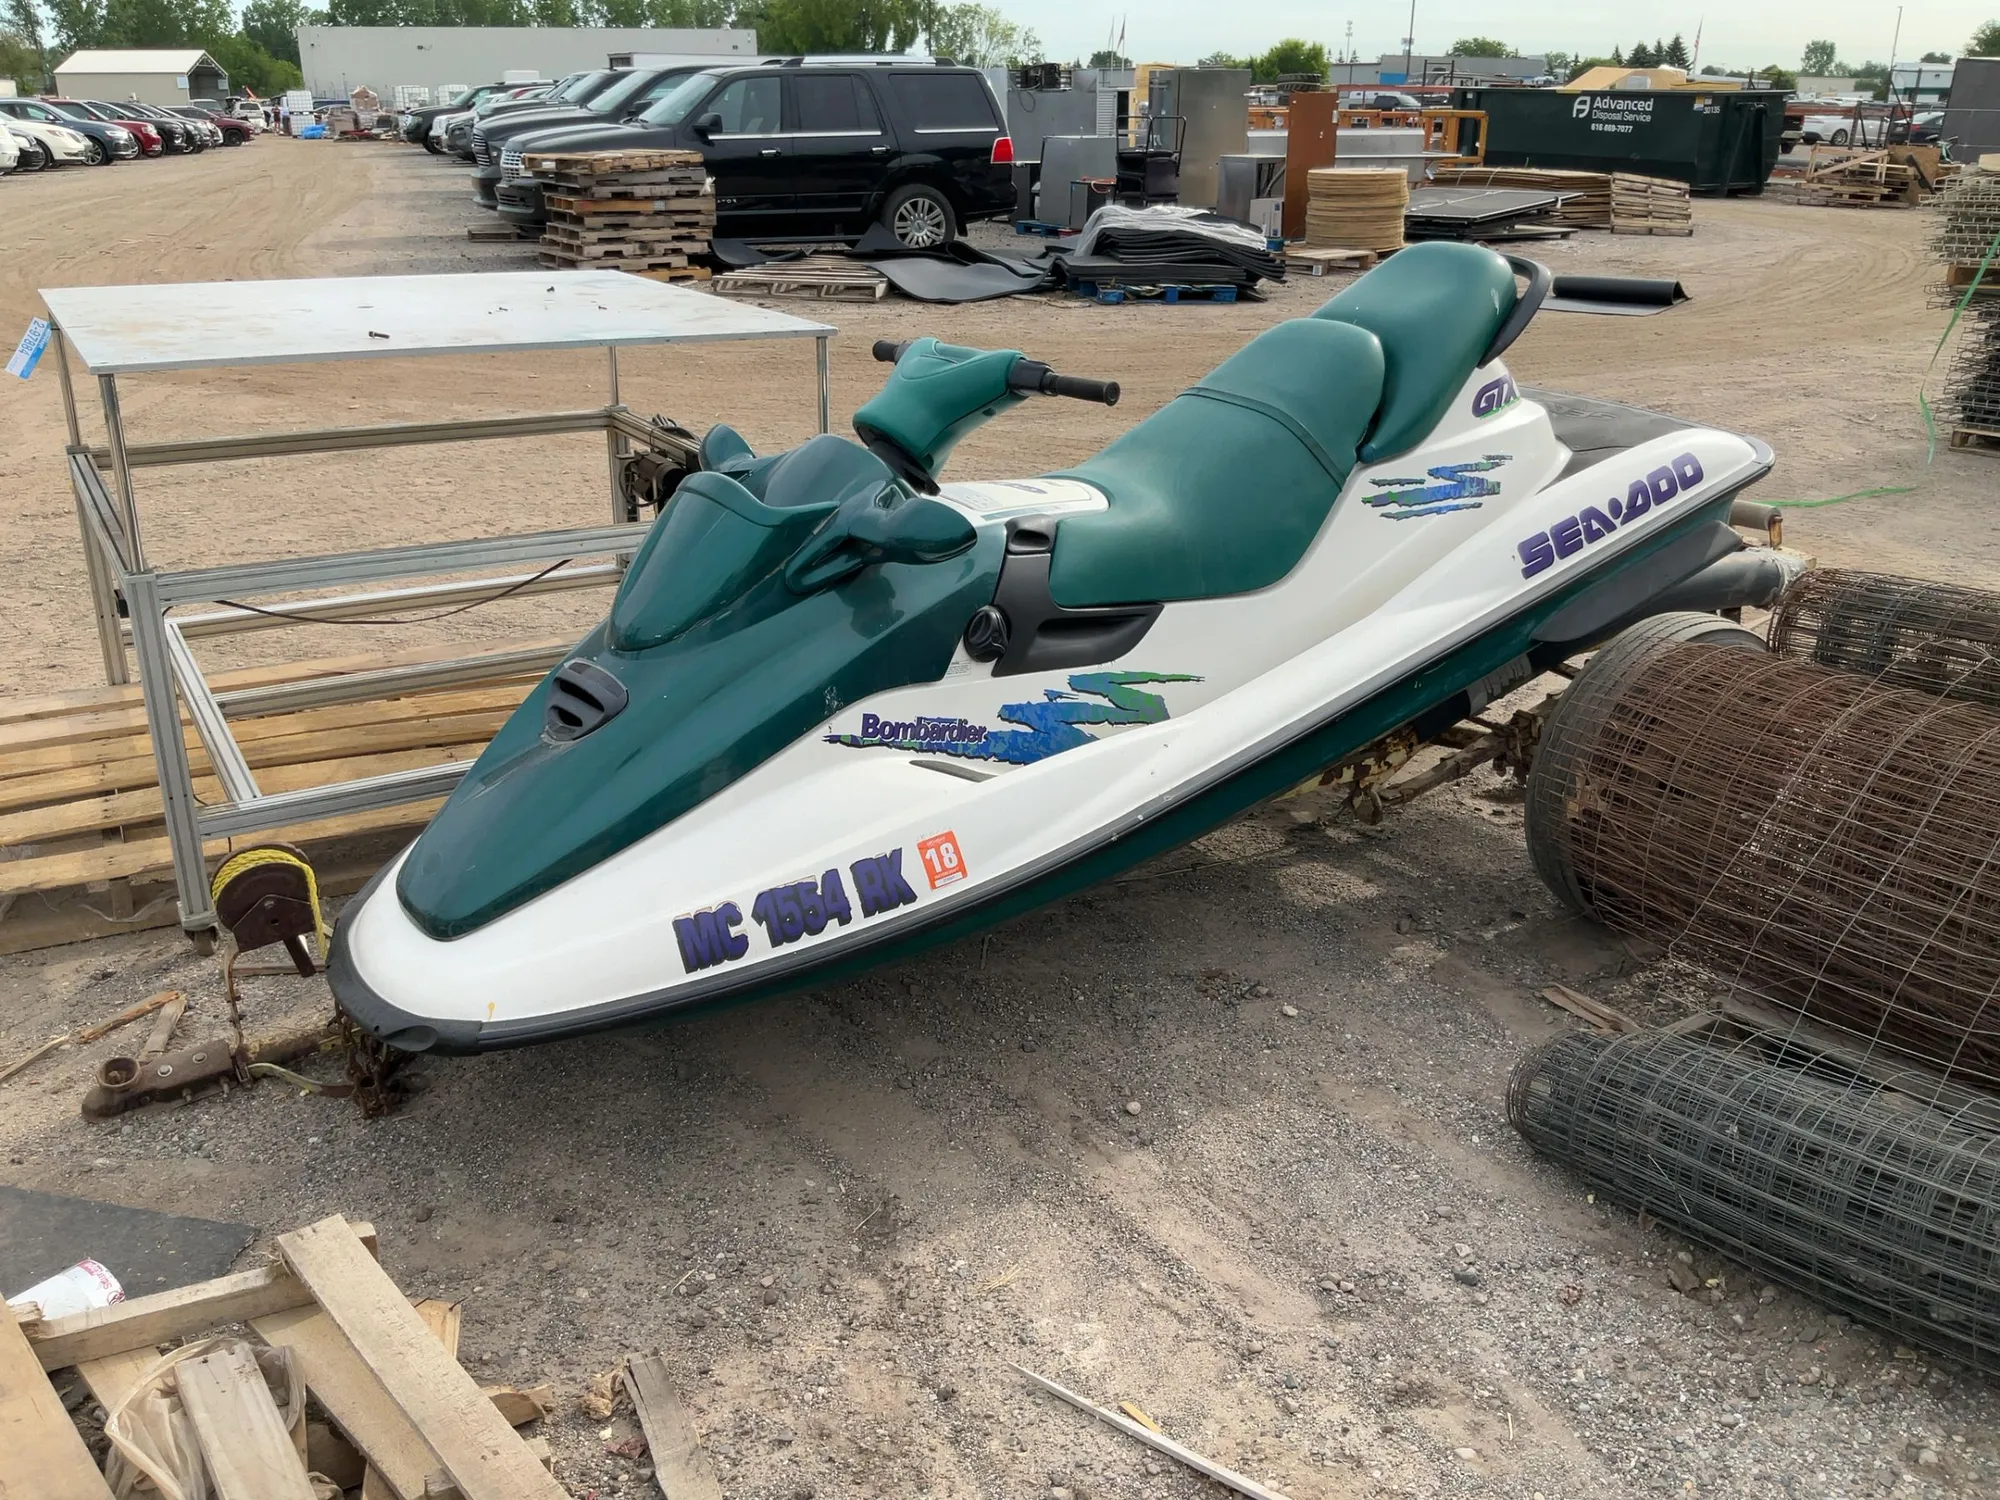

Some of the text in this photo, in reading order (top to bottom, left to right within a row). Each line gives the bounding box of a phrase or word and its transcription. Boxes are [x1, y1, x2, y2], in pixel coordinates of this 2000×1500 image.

[1592, 111, 1651, 122] Disposal Service
[1593, 96, 1654, 111] Advanced
[18, 320, 45, 356] 2-97884
[861, 713, 988, 743] Bombardier
[925, 842, 958, 873] 18
[672, 847, 918, 974] MC 1554 RK
